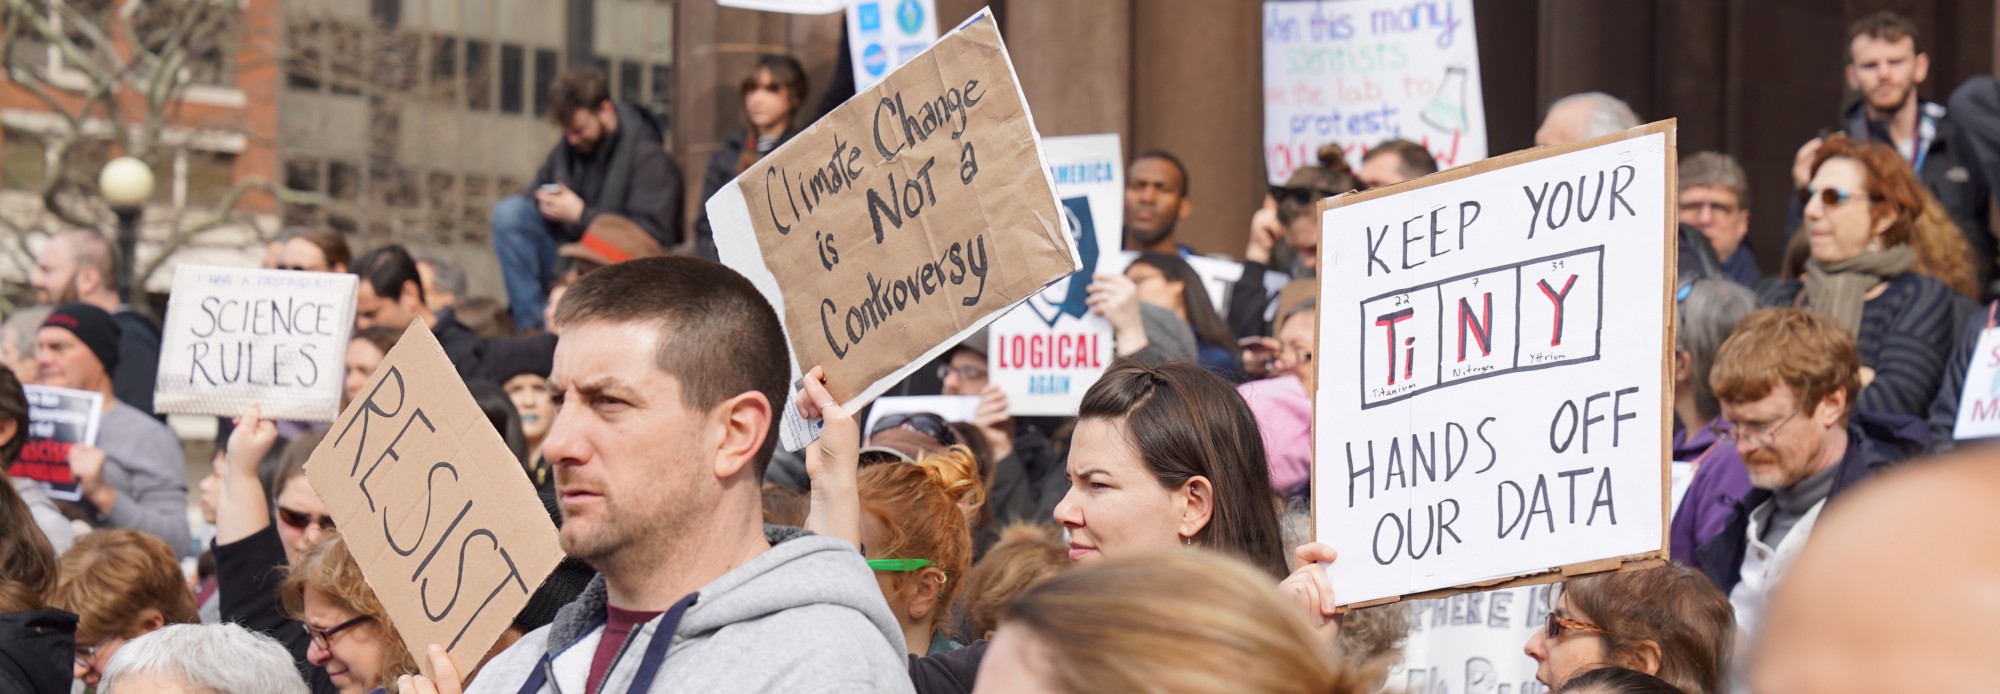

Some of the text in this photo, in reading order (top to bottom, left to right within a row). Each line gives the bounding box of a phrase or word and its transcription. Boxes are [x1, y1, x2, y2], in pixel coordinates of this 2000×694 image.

[1371, 0, 1462, 48] many
[1336, 76, 1383, 103] lab
[766, 79, 987, 235] Climate Change
[815, 141, 979, 271] is NOT a
[1366, 165, 1637, 277] KEEP YOUR
[820, 234, 988, 360] Controversy
[1394, 293, 1410, 307] 22
[1471, 277, 1480, 288] 7
[190, 296, 334, 338] SCIENCE
[187, 341, 318, 388] RULES
[999, 333, 1101, 369] LOGICAL
[1452, 365, 1495, 378] Nitrogen
[1028, 375, 1070, 395] AGAIN
[1372, 383, 1416, 399] Titanium
[1346, 386, 1640, 508] HANDS OFF
[333, 365, 529, 652] RESIST
[1372, 466, 1617, 565] OUR DATA
